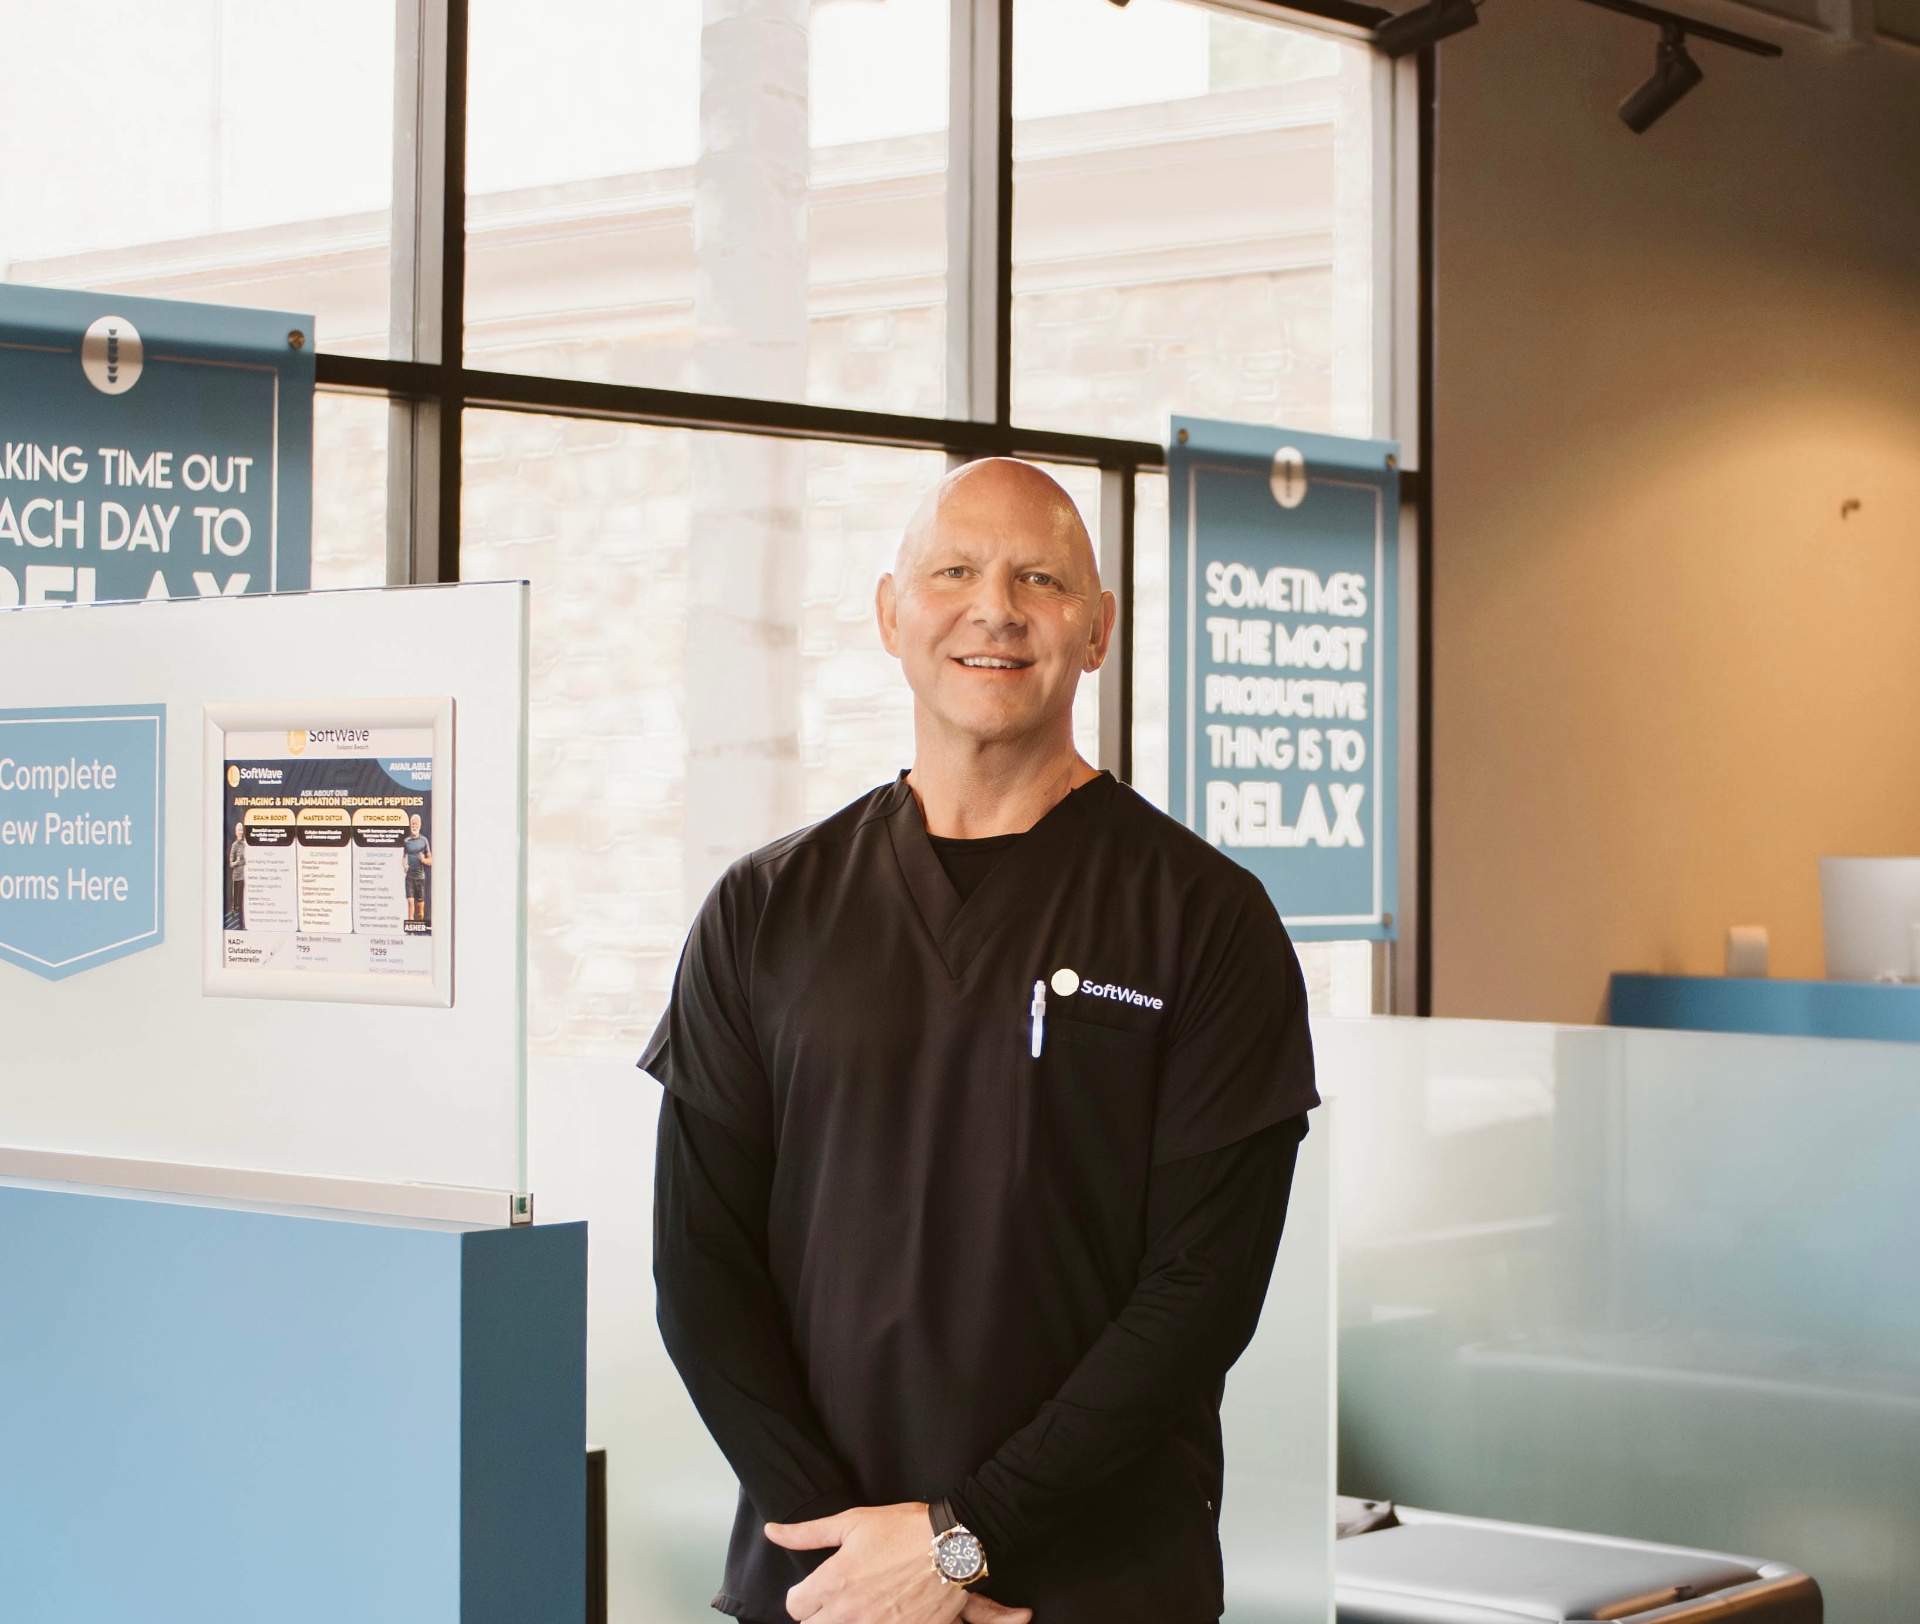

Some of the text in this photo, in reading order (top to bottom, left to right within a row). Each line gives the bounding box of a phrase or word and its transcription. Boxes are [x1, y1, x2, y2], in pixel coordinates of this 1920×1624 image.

[0, 442, 253, 494] KING TIME OUT
[100, 502, 180, 553] DAY
[193, 507, 252, 556] TO
[1206, 561, 1367, 618] SOMETIMES
[1206, 617, 1368, 672] THE MOST
[1205, 674, 1368, 721] PRODUCTIVE
[309, 730, 370, 742] SoftWave
[1206, 724, 1366, 773] THING IS TO
[0, 757, 117, 798] Complete
[240, 768, 283, 779] SoftWave
[389, 762, 431, 771] AVAILABLE
[412, 772, 431, 780] NOW
[234, 797, 423, 806] ANTI-AGING & INFLAMMATION REDUCING PEPTIDES
[1206, 781, 1366, 848] RELAX
[45, 812, 132, 846] Patient
[0, 868, 129, 902] orms Here
[1080, 980, 1164, 1010] SoftWave
